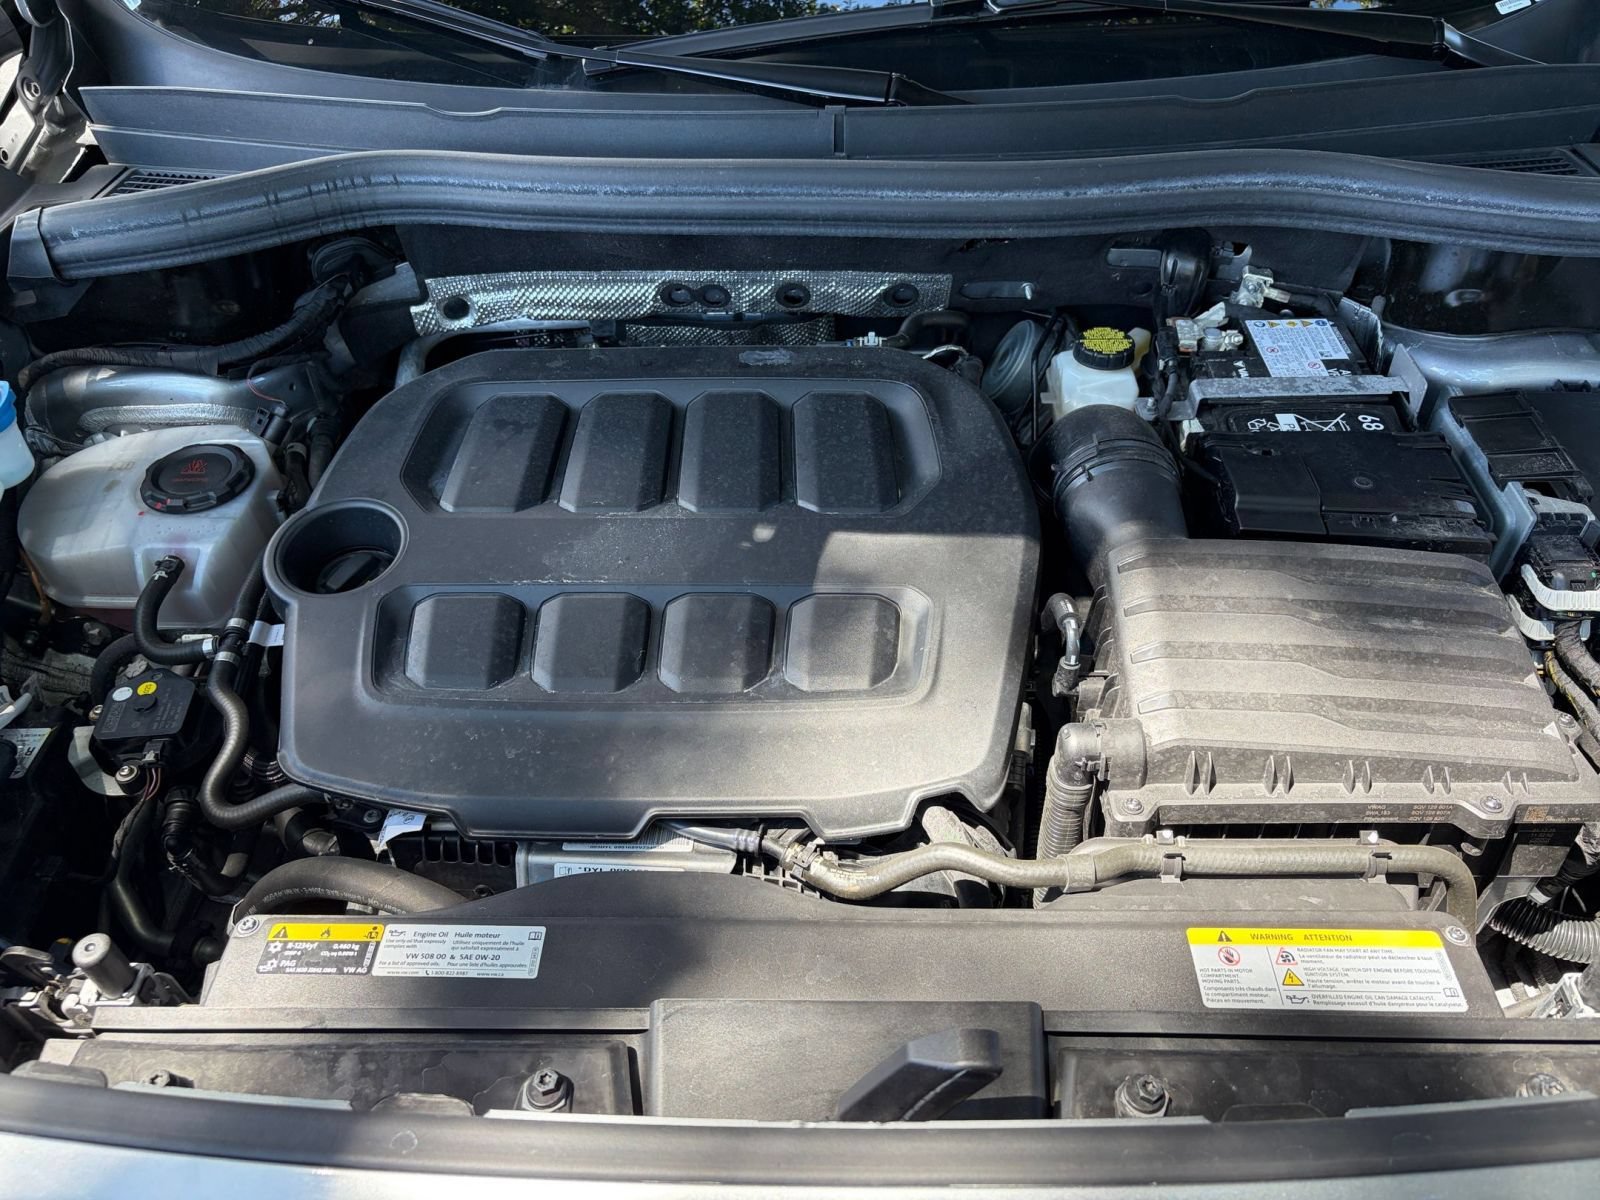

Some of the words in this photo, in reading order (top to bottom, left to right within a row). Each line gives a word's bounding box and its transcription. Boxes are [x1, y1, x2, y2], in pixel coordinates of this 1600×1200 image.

[1358, 414, 1384, 431] 68
[413, 931, 437, 939] Engine
[1249, 933, 1294, 941] WARNING
[1303, 934, 1353, 942] ATTENTION
